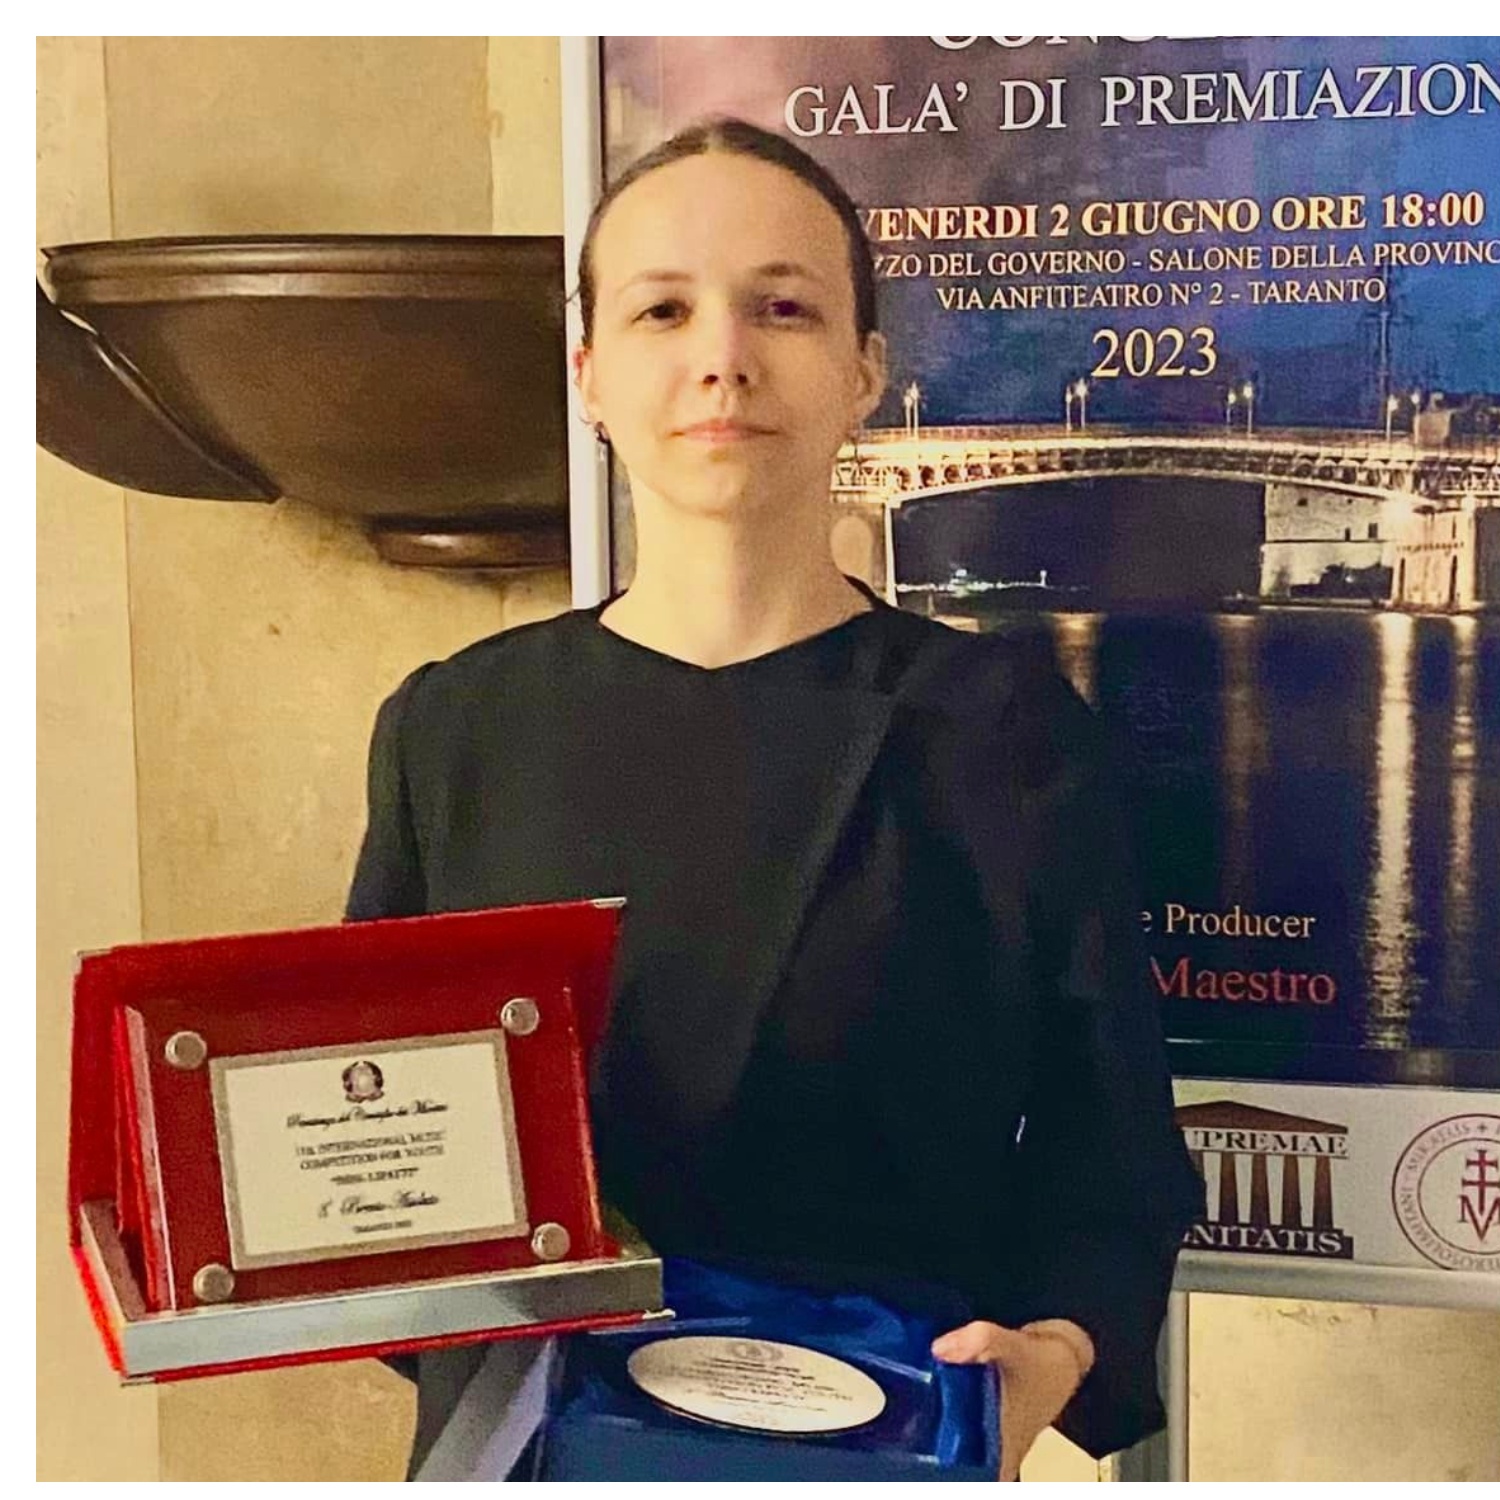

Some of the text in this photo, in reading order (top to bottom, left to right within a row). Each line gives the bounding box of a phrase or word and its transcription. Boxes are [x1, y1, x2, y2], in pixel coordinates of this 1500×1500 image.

[1000, 78, 1067, 132] DI
[1050, 203, 1070, 237] 2
[1082, 198, 1261, 236] GIUGNO
[1272, 195, 1367, 233] ORE
[1381, 190, 1486, 229] 18:00
[929, 252, 982, 277] DEL
[988, 248, 1126, 275] GOVERNO
[1149, 245, 1262, 272] SALONE
[1271, 242, 1367, 269] DELLA
[936, 287, 985, 311] VIA
[989, 284, 1162, 310] ANFITEATRO
[1210, 281, 1223, 304] 2
[1250, 277, 1387, 303] TARANTO
[1091, 327, 1218, 378] 2023
[1165, 903, 1316, 938] Producer
[1150, 954, 1337, 1004] Maestro
